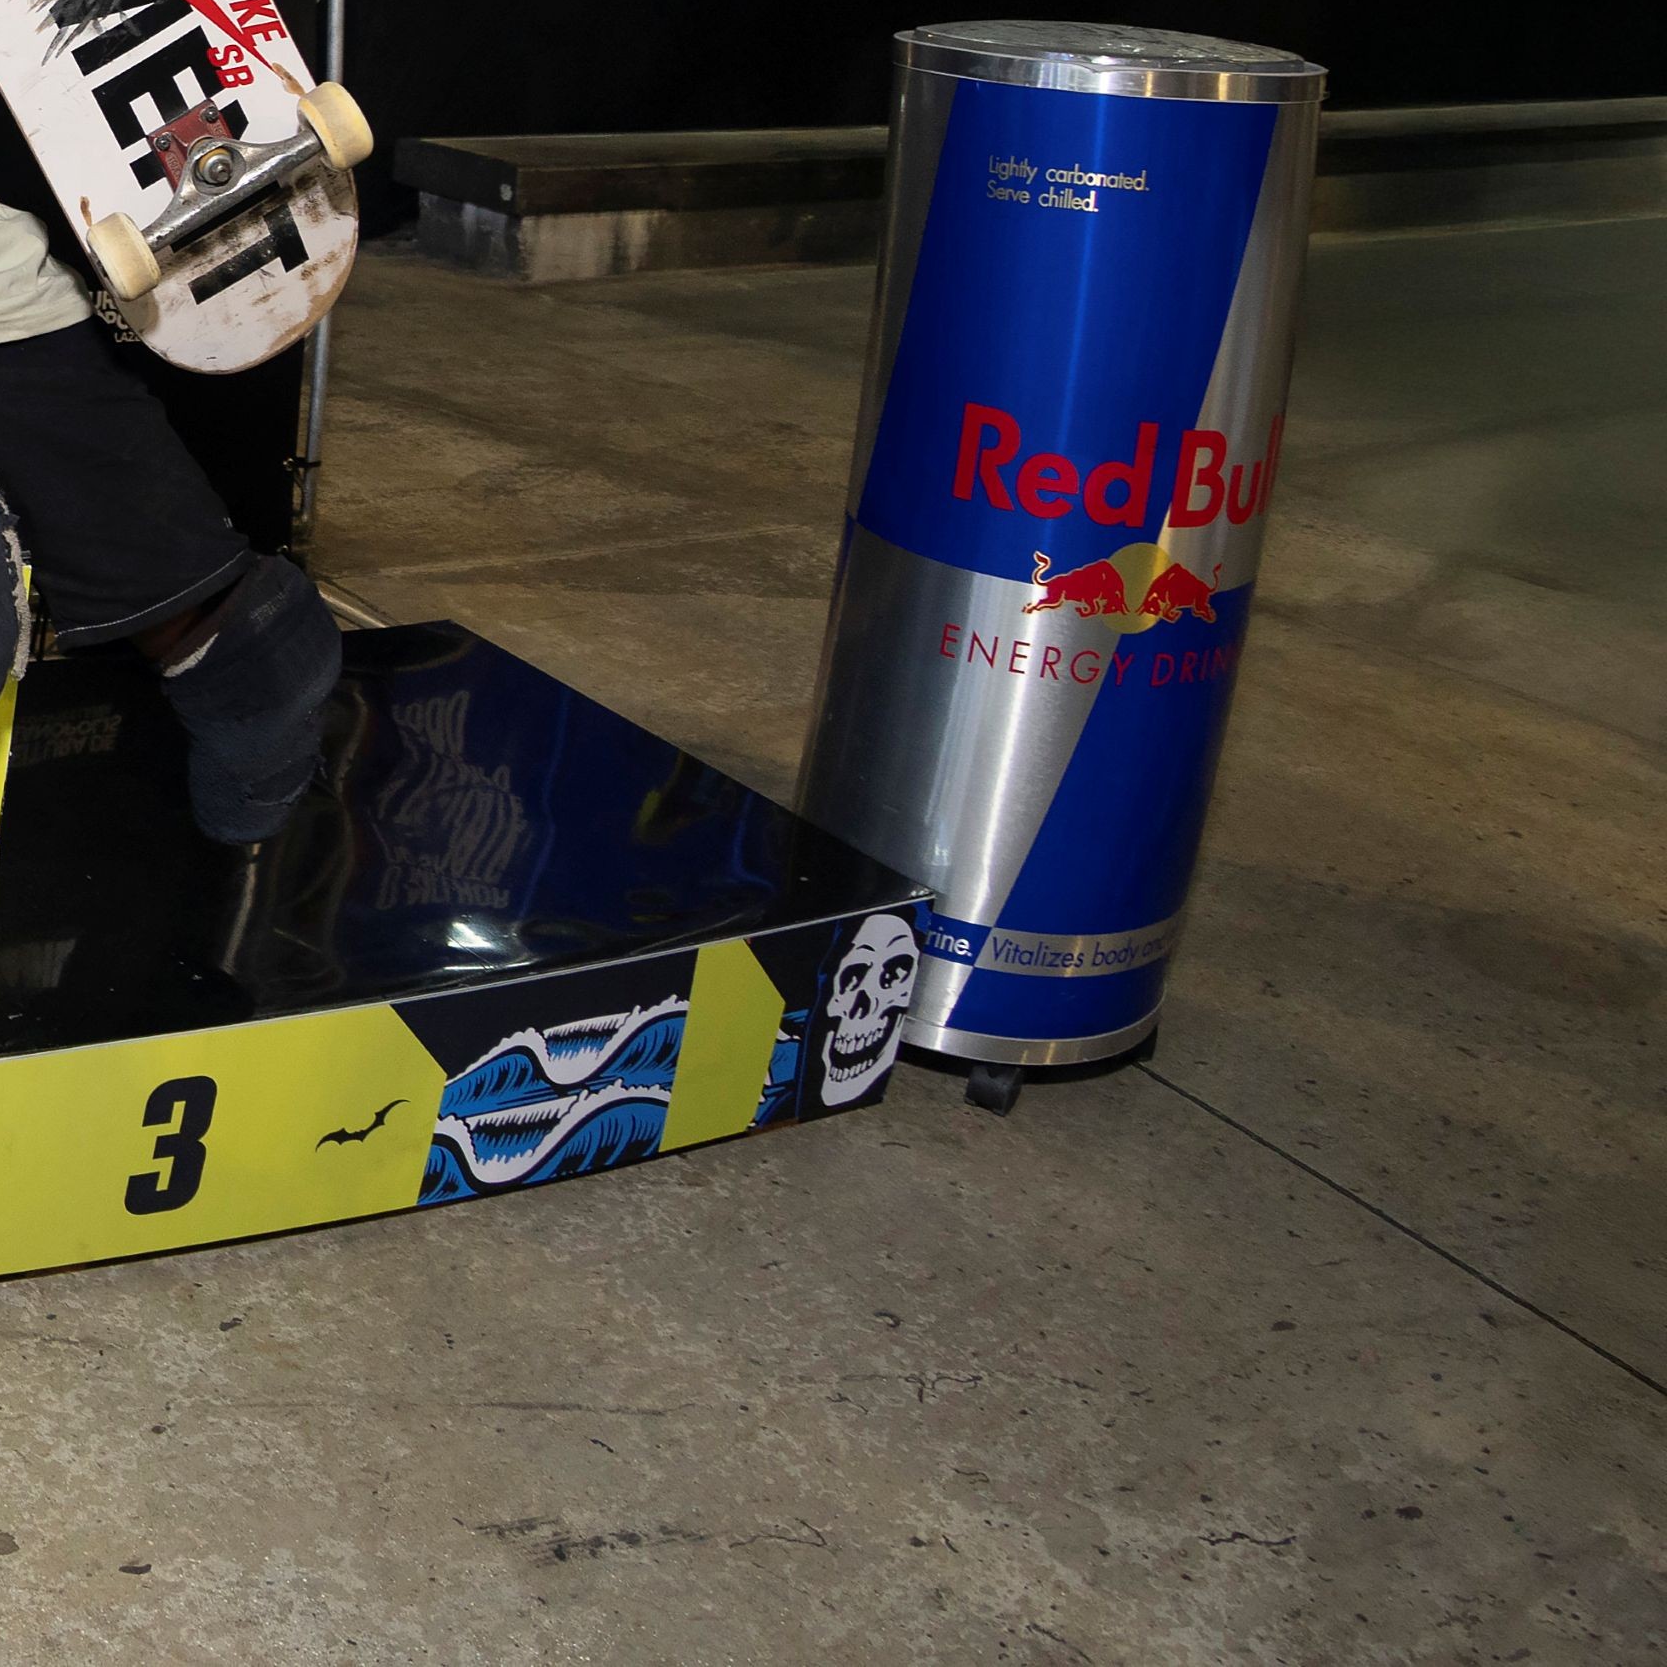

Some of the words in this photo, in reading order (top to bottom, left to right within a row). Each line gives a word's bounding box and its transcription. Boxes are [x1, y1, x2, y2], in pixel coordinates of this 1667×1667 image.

[206, 43, 253, 90] SB
[986, 180, 1030, 206] Serve
[1038, 186, 1100, 213] chilled.
[988, 156, 1038, 185] Lightly
[1045, 162, 1150, 192] carbonated.
[951, 401, 1159, 528] Red
[939, 623, 1132, 687] ENERGY
[991, 936, 1085, 968] Vitalizes
[1091, 944, 1138, 970] body
[124, 1075, 218, 1216] 3
